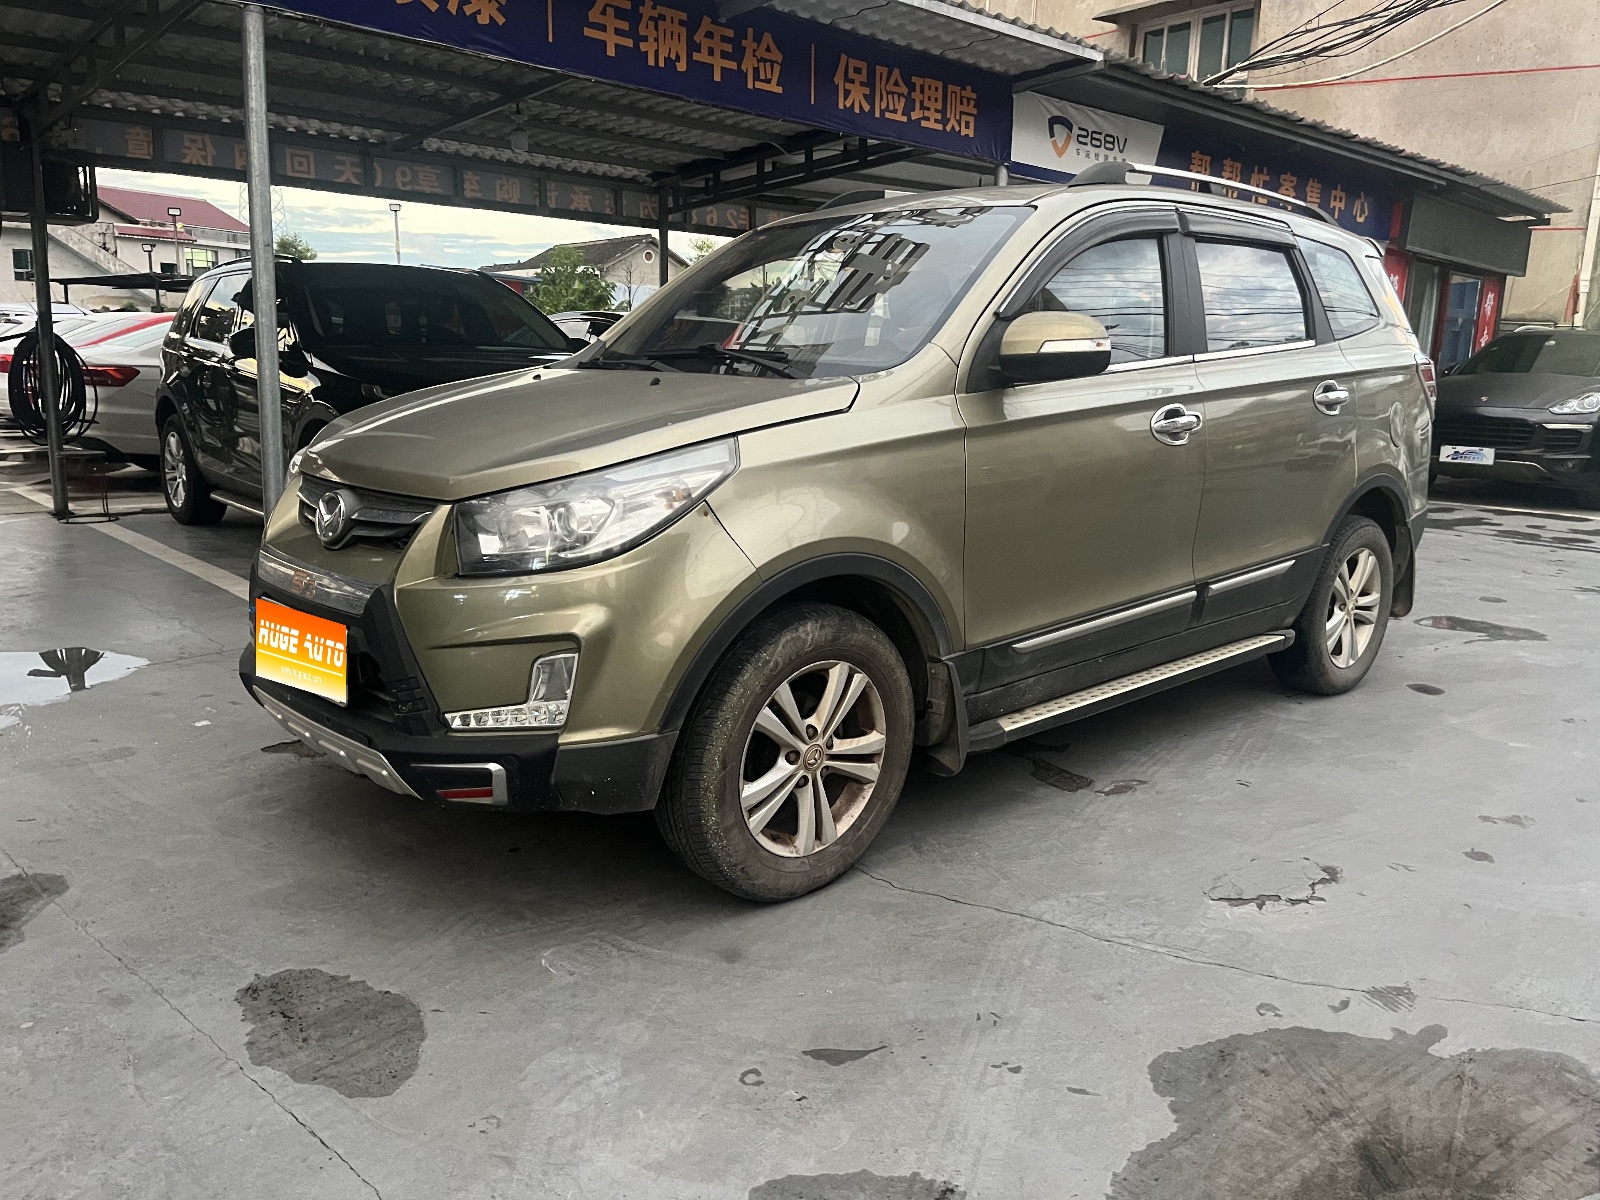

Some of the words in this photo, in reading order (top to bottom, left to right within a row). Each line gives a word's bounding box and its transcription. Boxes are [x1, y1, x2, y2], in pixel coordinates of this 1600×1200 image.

[583, 0, 784, 94] 车辆年检
[833, 53, 978, 138] 保险理赔
[1076, 126, 1128, 154] 268V
[290, 570, 318, 599] S3
